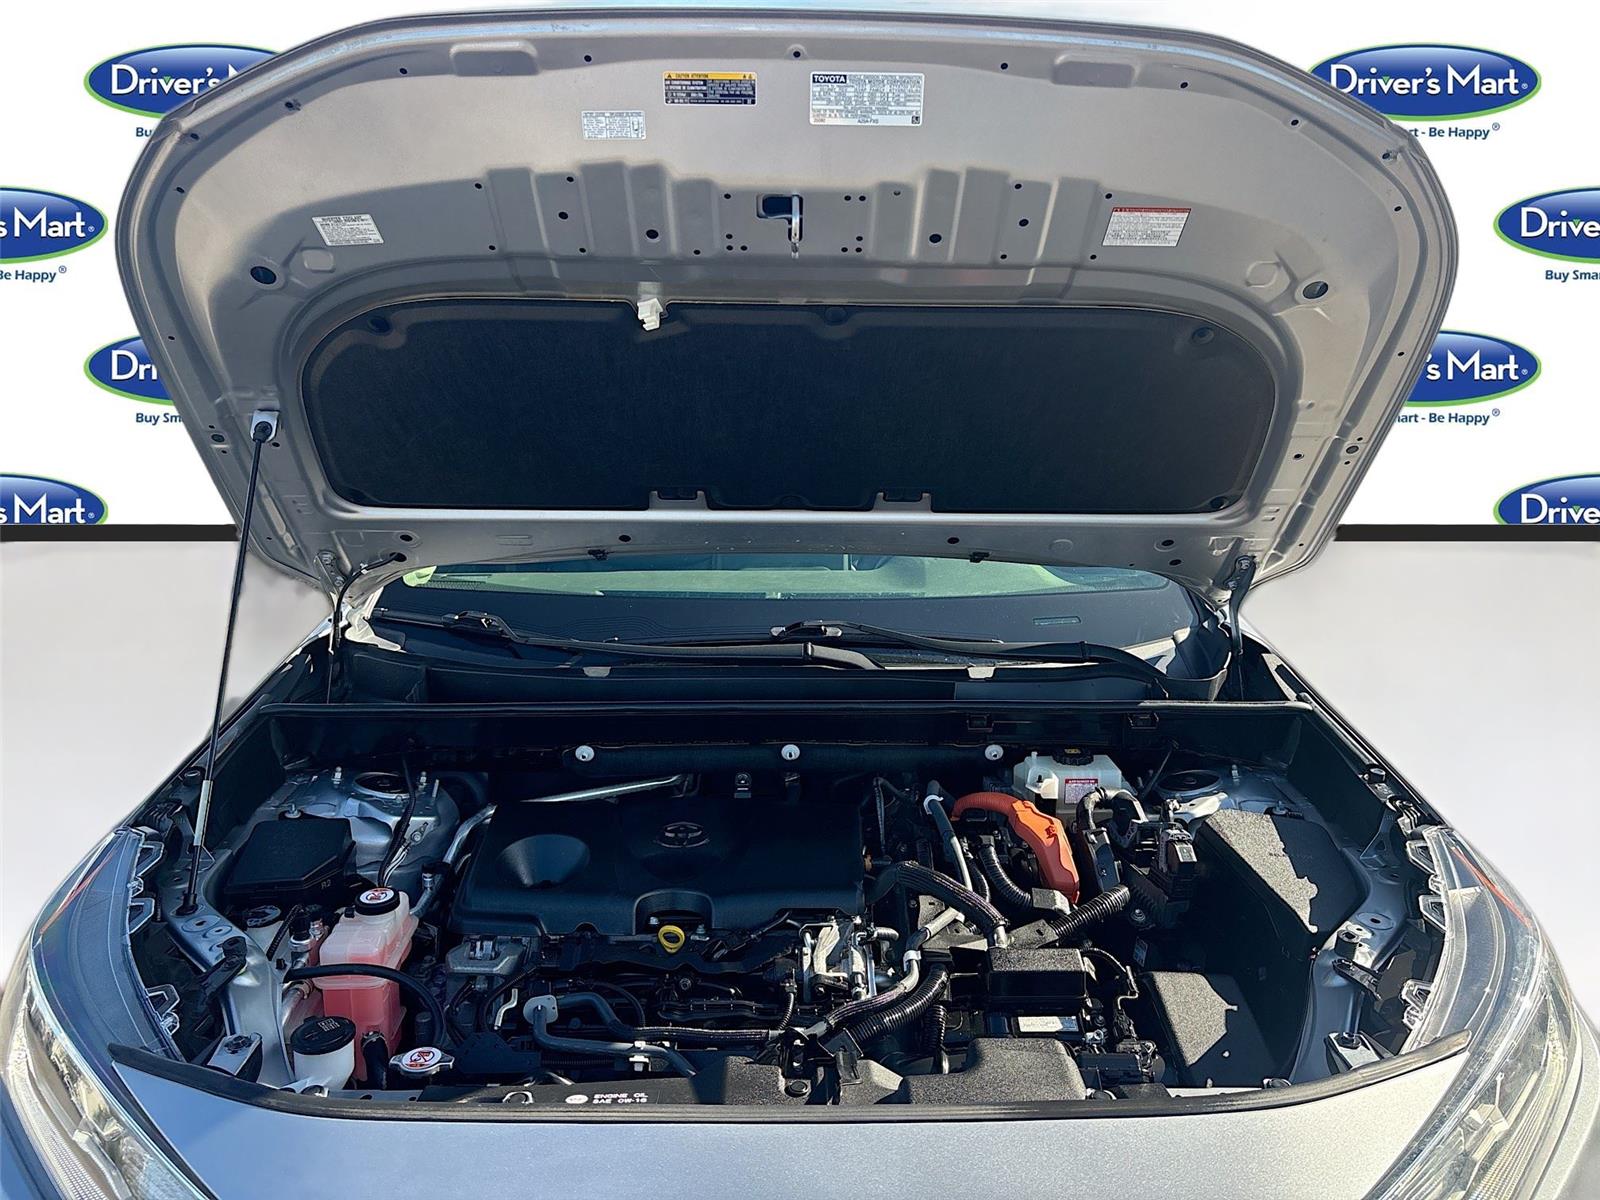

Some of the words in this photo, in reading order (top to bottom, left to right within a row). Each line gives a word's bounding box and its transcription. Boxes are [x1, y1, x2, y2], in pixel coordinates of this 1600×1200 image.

[813, 75, 846, 83] TOYOTA
[1330, 63, 1441, 95] Driver's
[1447, 63, 1519, 95] Mart
[136, 127, 152, 137] Bu
[1428, 127, 1445, 137] Be
[1448, 127, 1490, 140] Happy
[14, 206, 86, 238] Mart
[1521, 206, 1600, 238] Drive
[15, 270, 57, 283] Happy
[1545, 270, 1569, 283] Buy
[1572, 270, 1600, 280] Sma
[1447, 349, 1519, 380] Mart
[136, 413, 160, 426] Buy
[1398, 413, 1419, 423] art
[1429, 412, 1445, 423] Be
[1448, 412, 1490, 426] Happy
[14, 492, 86, 524] Mart
[1521, 493, 1600, 524] Drive
